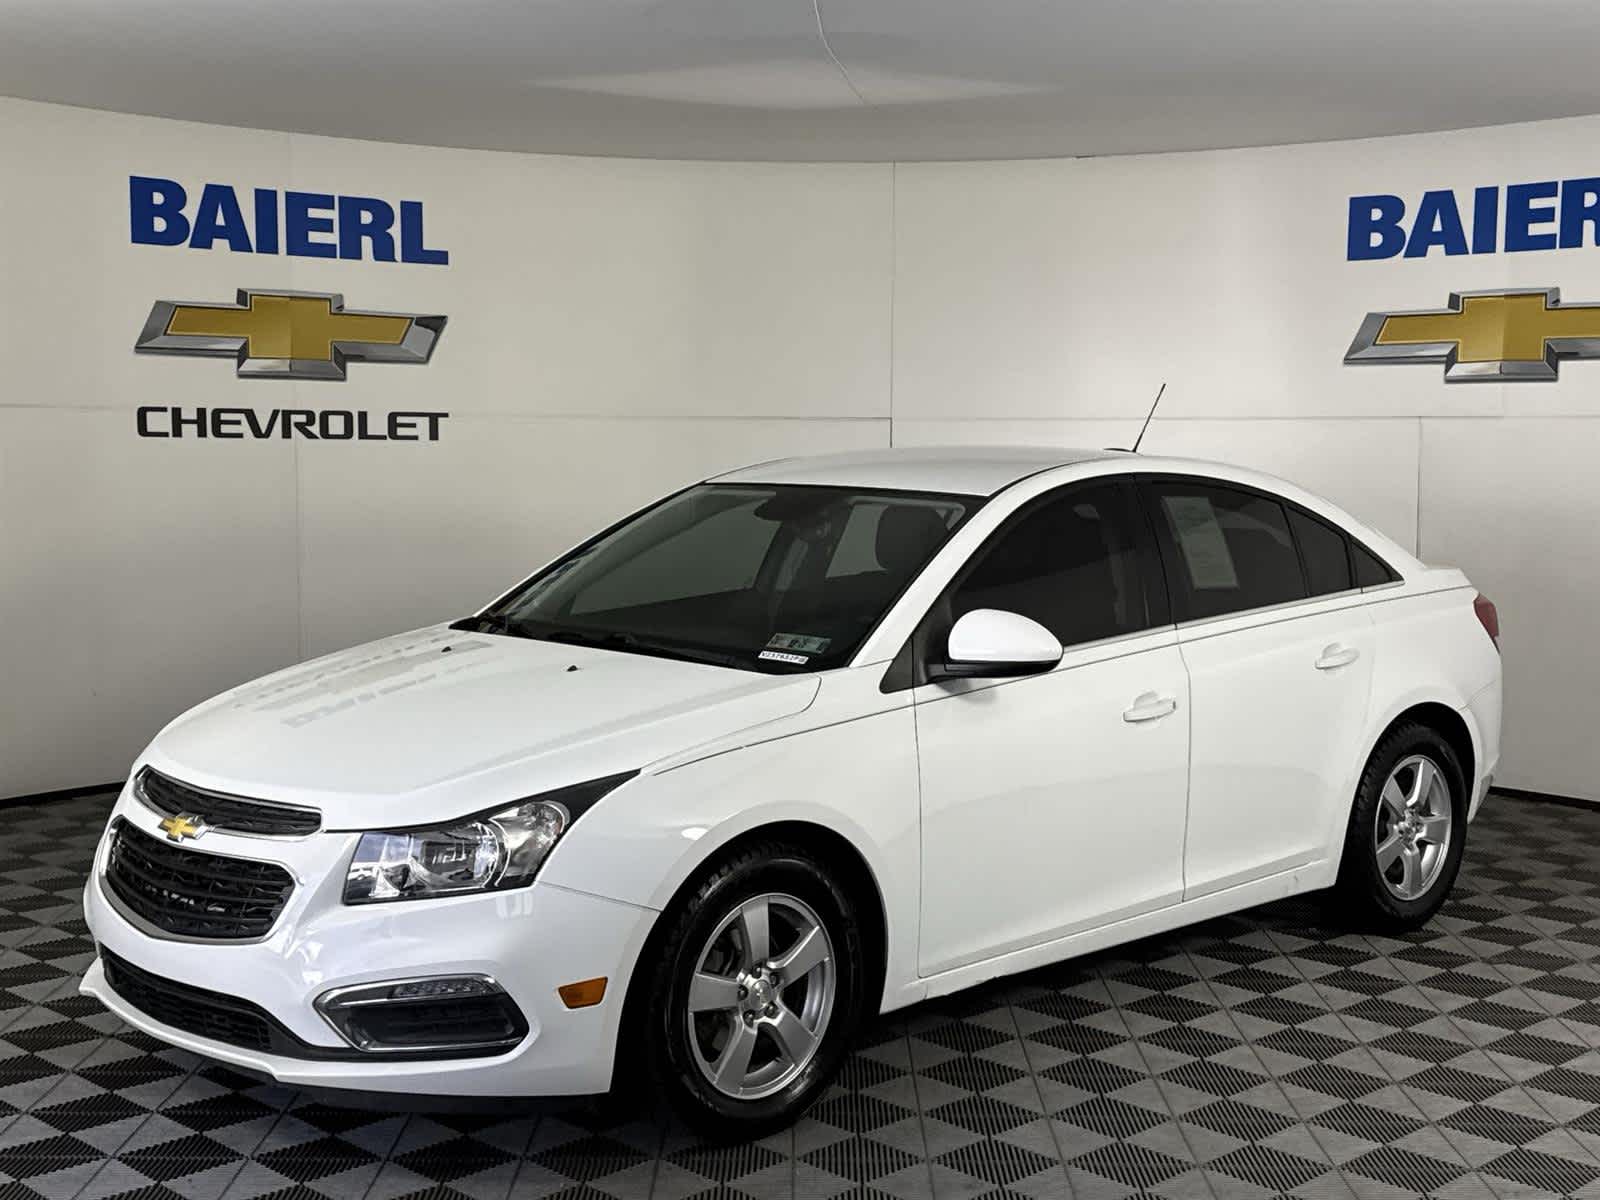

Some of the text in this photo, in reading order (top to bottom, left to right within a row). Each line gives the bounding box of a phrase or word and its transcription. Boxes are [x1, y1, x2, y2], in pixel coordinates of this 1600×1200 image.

[130, 175, 449, 265] BAIERL
[1347, 177, 1600, 261] BAIER
[136, 406, 449, 441] CHEVROLET
